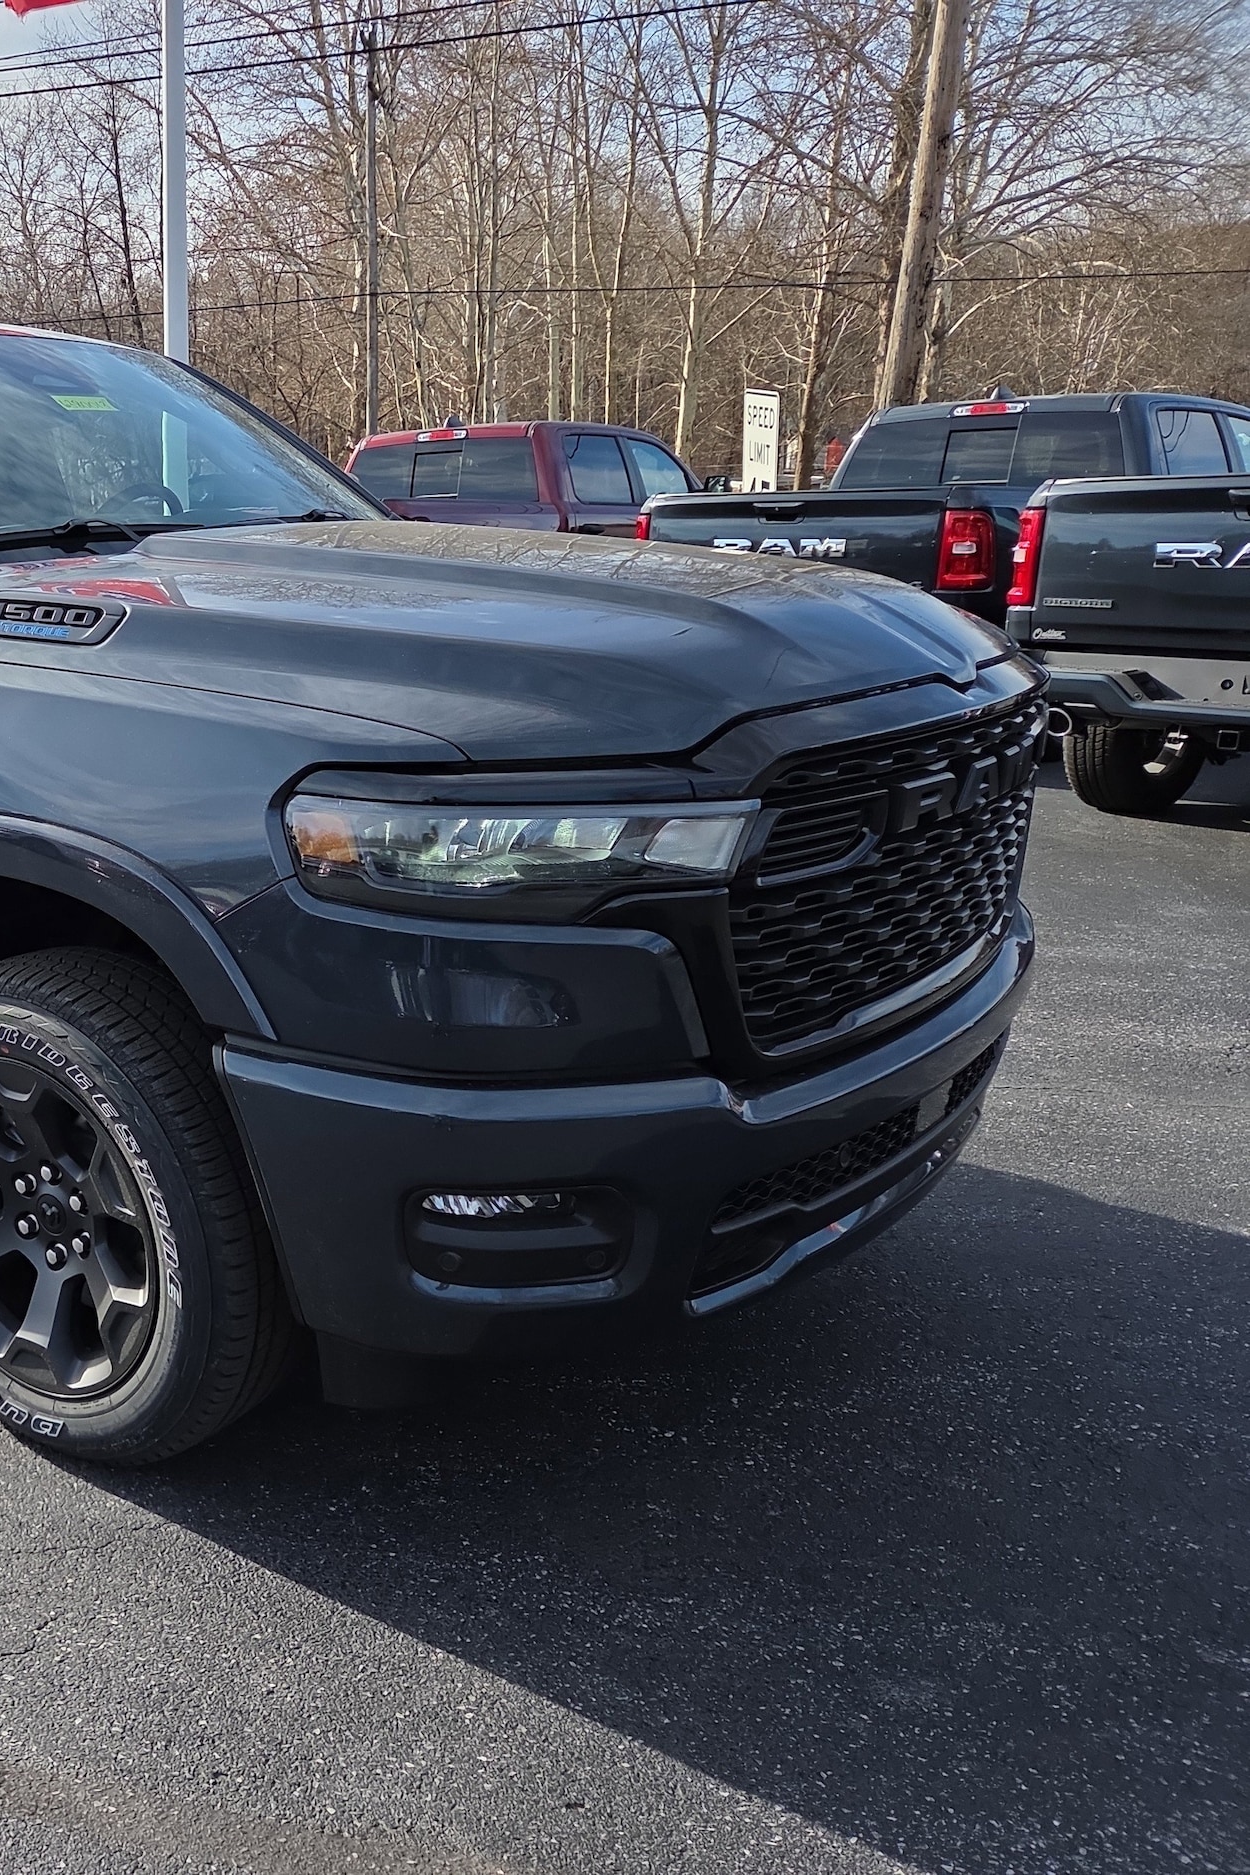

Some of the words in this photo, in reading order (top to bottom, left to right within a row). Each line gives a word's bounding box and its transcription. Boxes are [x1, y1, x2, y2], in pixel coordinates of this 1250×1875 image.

[747, 404, 775, 430] SPEED
[748, 440, 770, 466] LIMIT
[709, 538, 848, 559] RAM
[897, 736, 1035, 834] RAM
